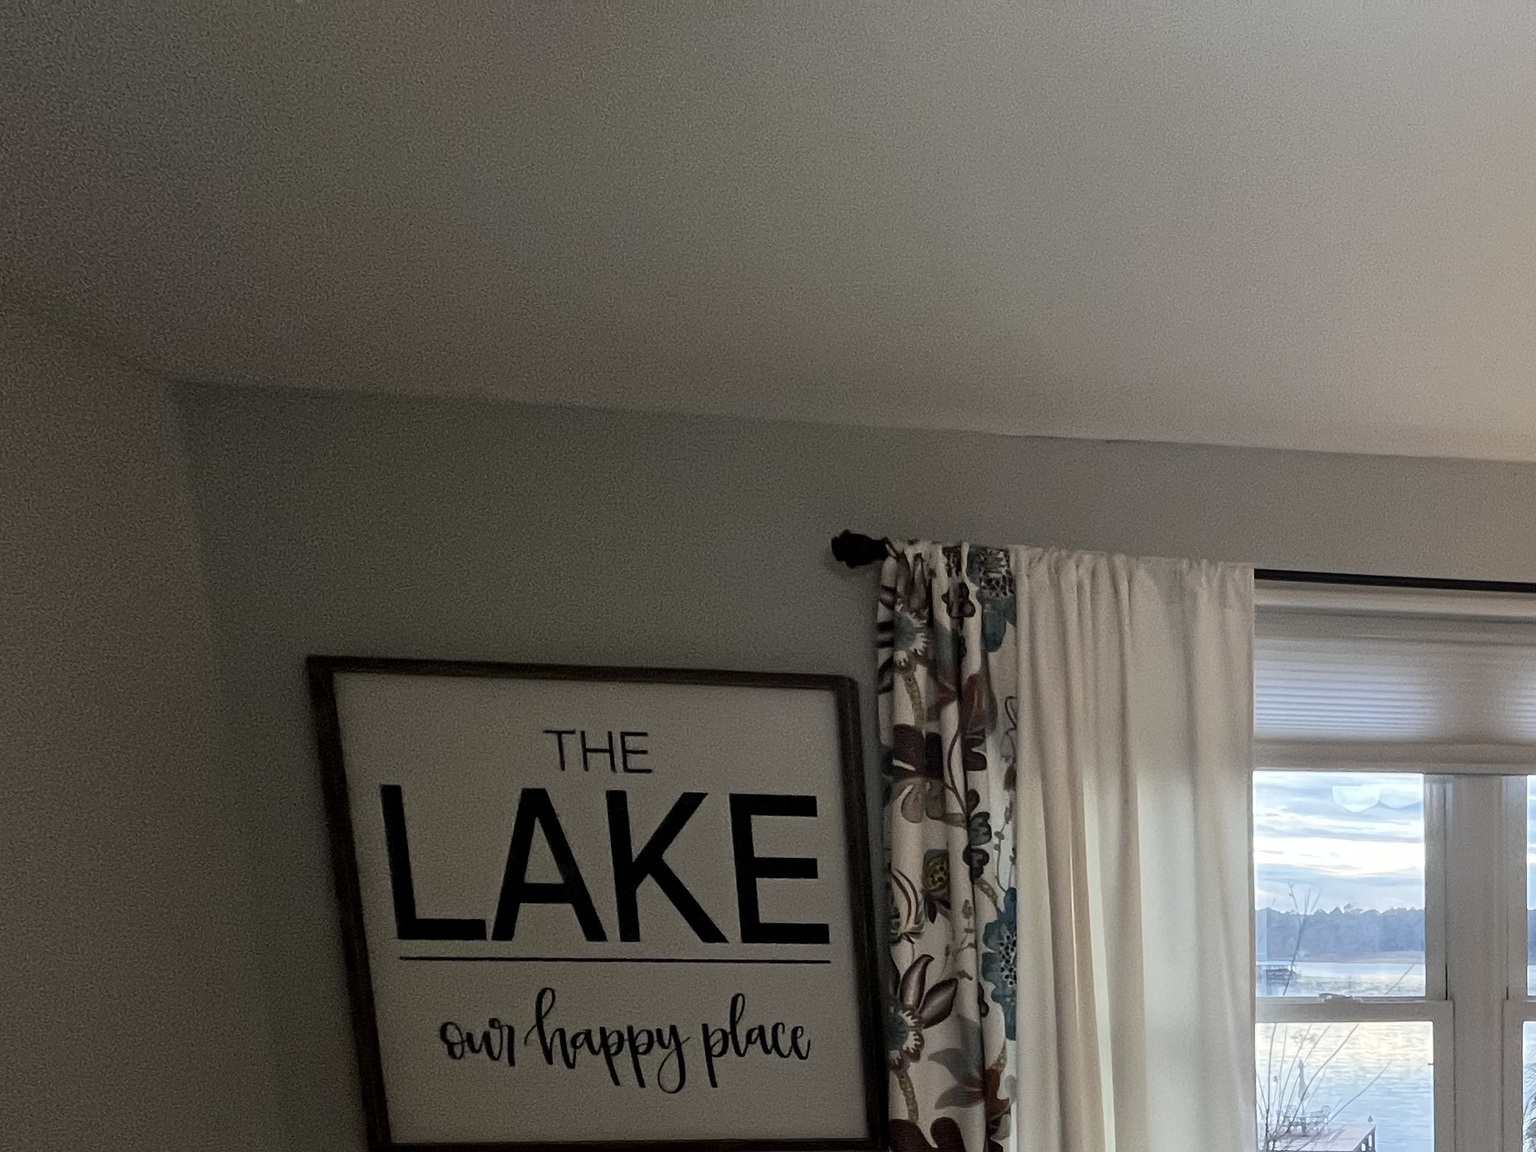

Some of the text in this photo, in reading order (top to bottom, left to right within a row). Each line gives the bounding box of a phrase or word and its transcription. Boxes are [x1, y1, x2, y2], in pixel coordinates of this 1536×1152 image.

[543, 729, 653, 773] THE
[380, 784, 831, 945] LAKE
[439, 987, 811, 1095] our happy place
